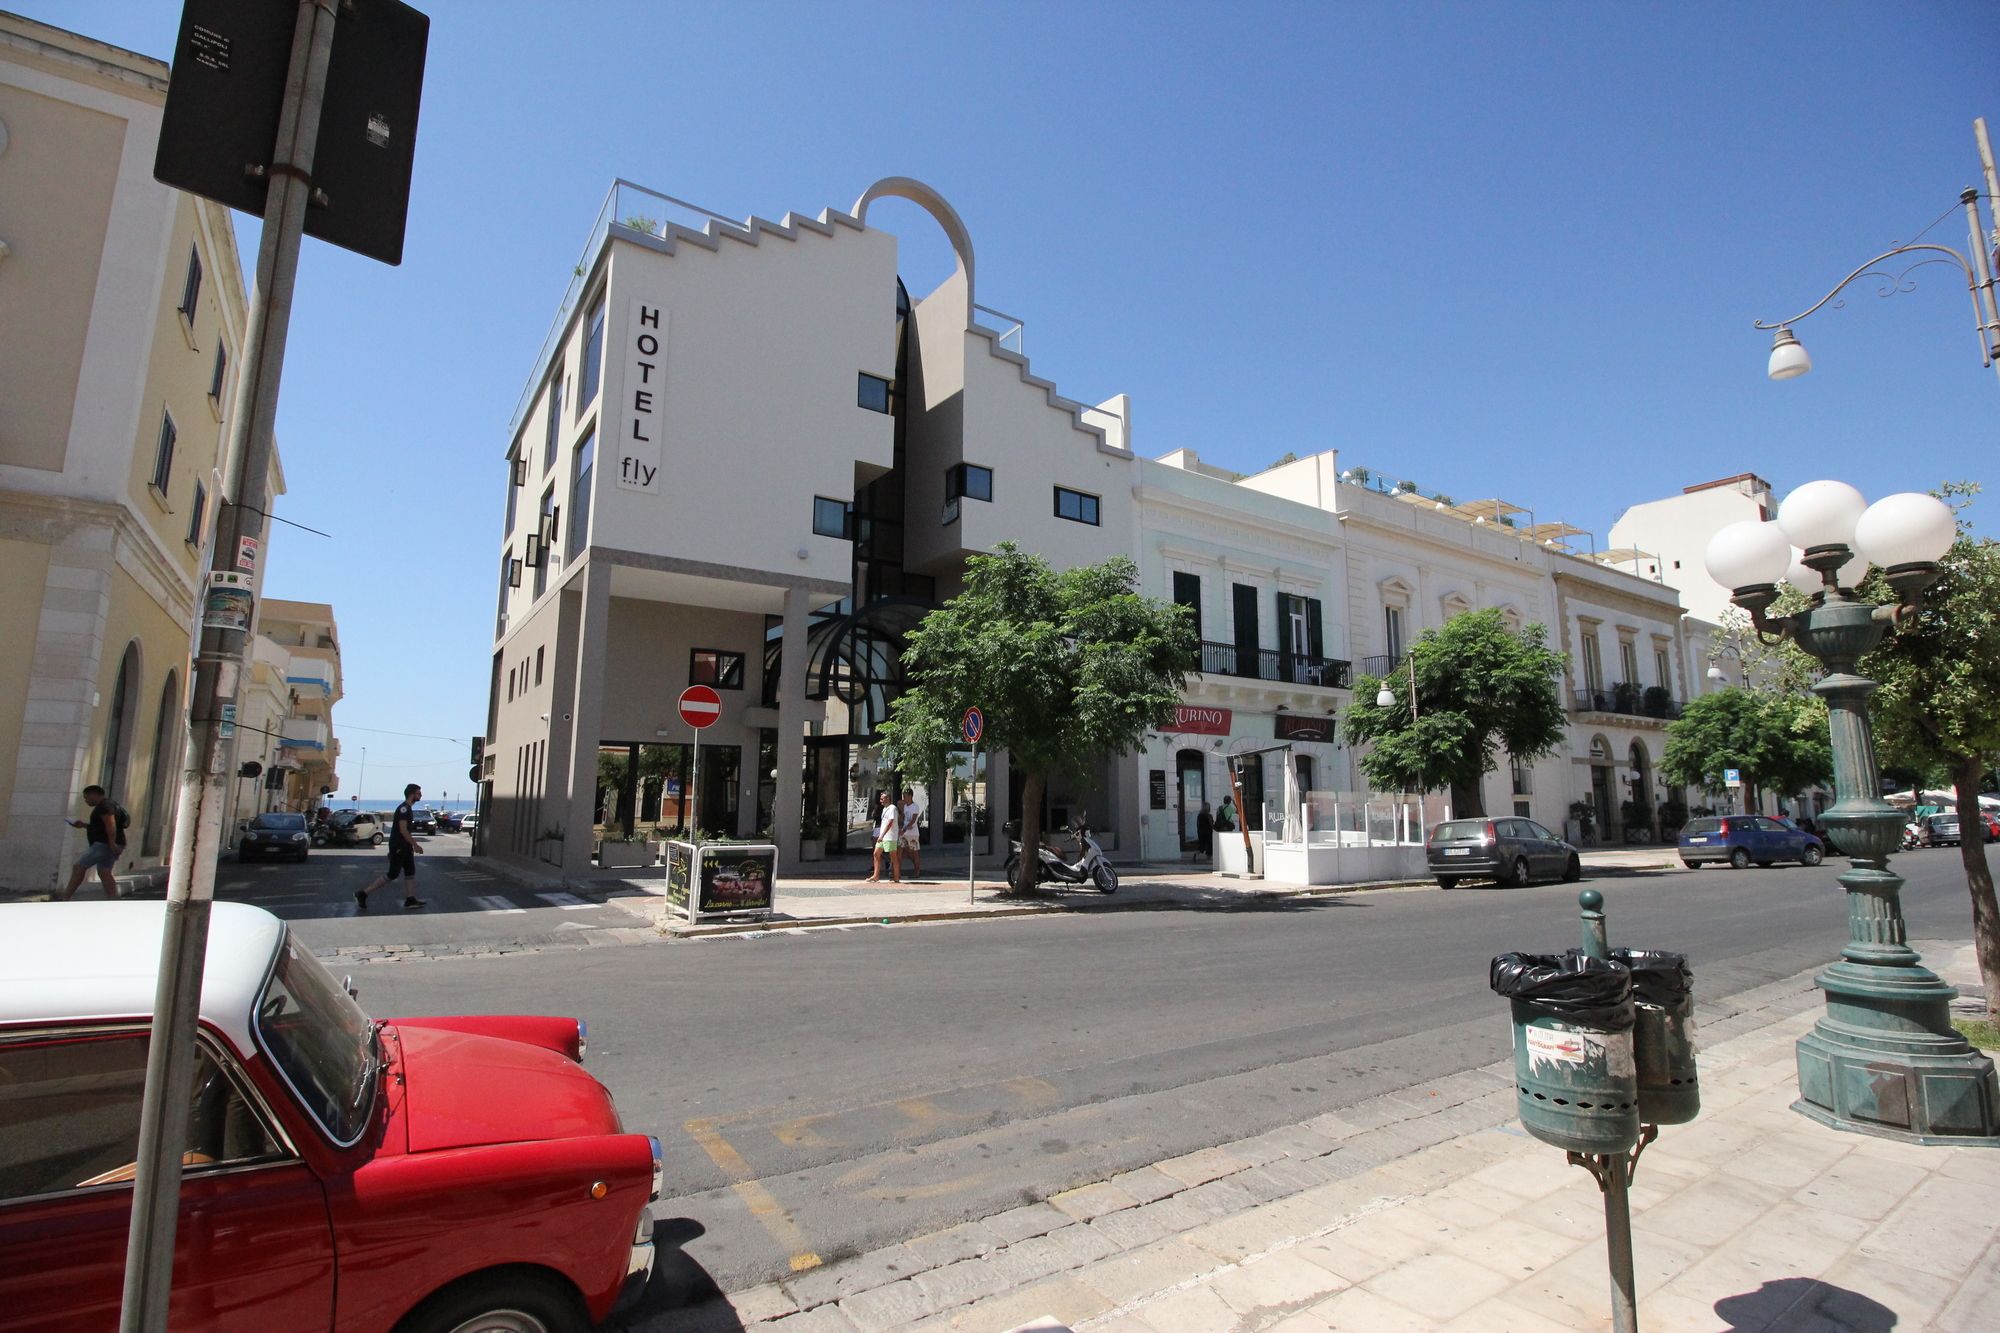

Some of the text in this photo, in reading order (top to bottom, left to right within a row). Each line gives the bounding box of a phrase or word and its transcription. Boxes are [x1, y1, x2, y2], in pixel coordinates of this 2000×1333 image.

[194, 25, 222, 39] COMUNE
[194, 32, 228, 49] GALLIPOLI
[633, 306, 659, 441] HOTEL
[1173, 707, 1222, 727] RUBINO
[1727, 770, 1736, 779] P
